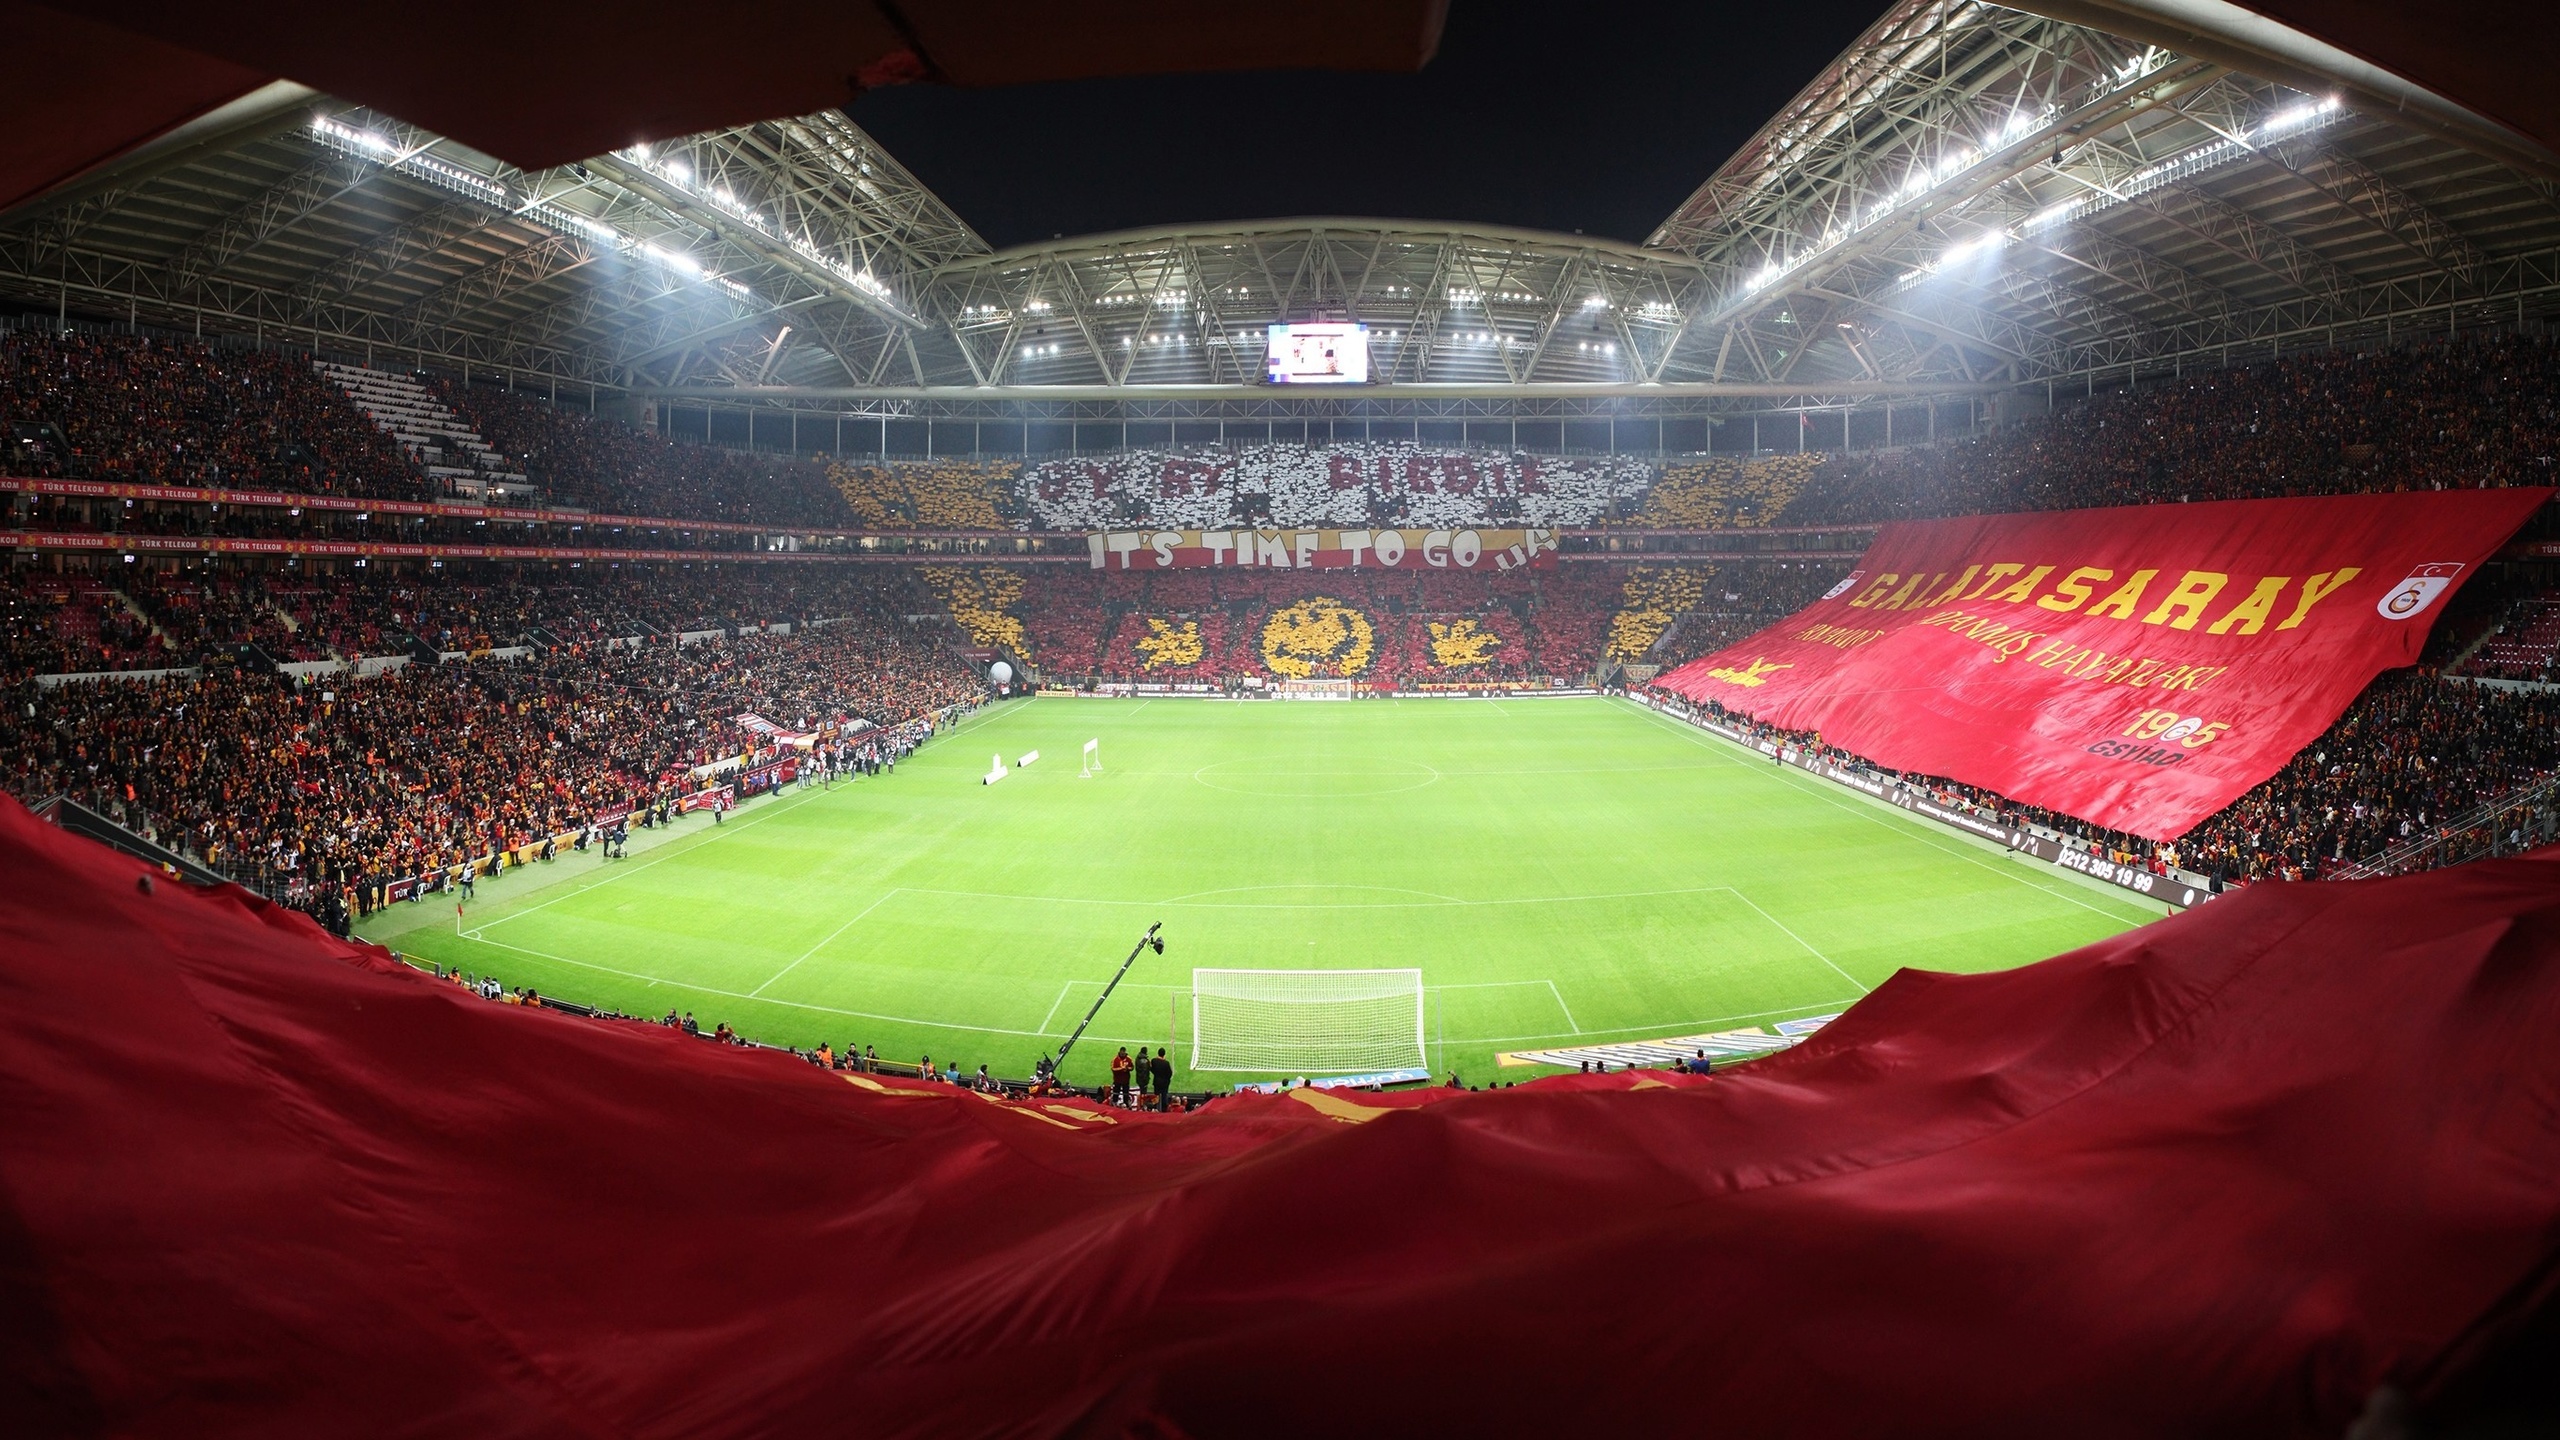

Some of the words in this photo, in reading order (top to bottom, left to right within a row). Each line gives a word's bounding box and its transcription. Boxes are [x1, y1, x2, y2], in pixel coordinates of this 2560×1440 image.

[43, 482, 65, 491] TÜRK
[68, 484, 105, 493] TELEKOM
[142, 488, 162, 497] TÜRK
[165, 490, 198, 499] TELEKOM
[232, 493, 250, 502] TÜRK
[311, 498, 328, 506] TÜRK
[330, 501, 357, 509] TELEKOM
[42, 536, 64, 545] TÜRK
[68, 538, 103, 546] TELEKOM
[141, 539, 161, 547] TÜRK
[164, 541, 197, 549] TELEKOM
[231, 542, 249, 550] TÜRK
[311, 544, 327, 552] TÜRK
[1088, 530, 1184, 569] IT'S
[1201, 530, 1319, 569] TIME
[1339, 529, 1405, 567] TO
[1422, 529, 1482, 567] GO
[1848, 563, 2362, 635] GALATASARAY
[2026, 640, 2228, 691] HAYATLAR!
[2059, 849, 2087, 871] 0212
[2089, 860, 2114, 879] 305
[2116, 867, 2133, 886] 19
[2133, 875, 2153, 892] 99
[394, 888, 408, 899] TÜR
